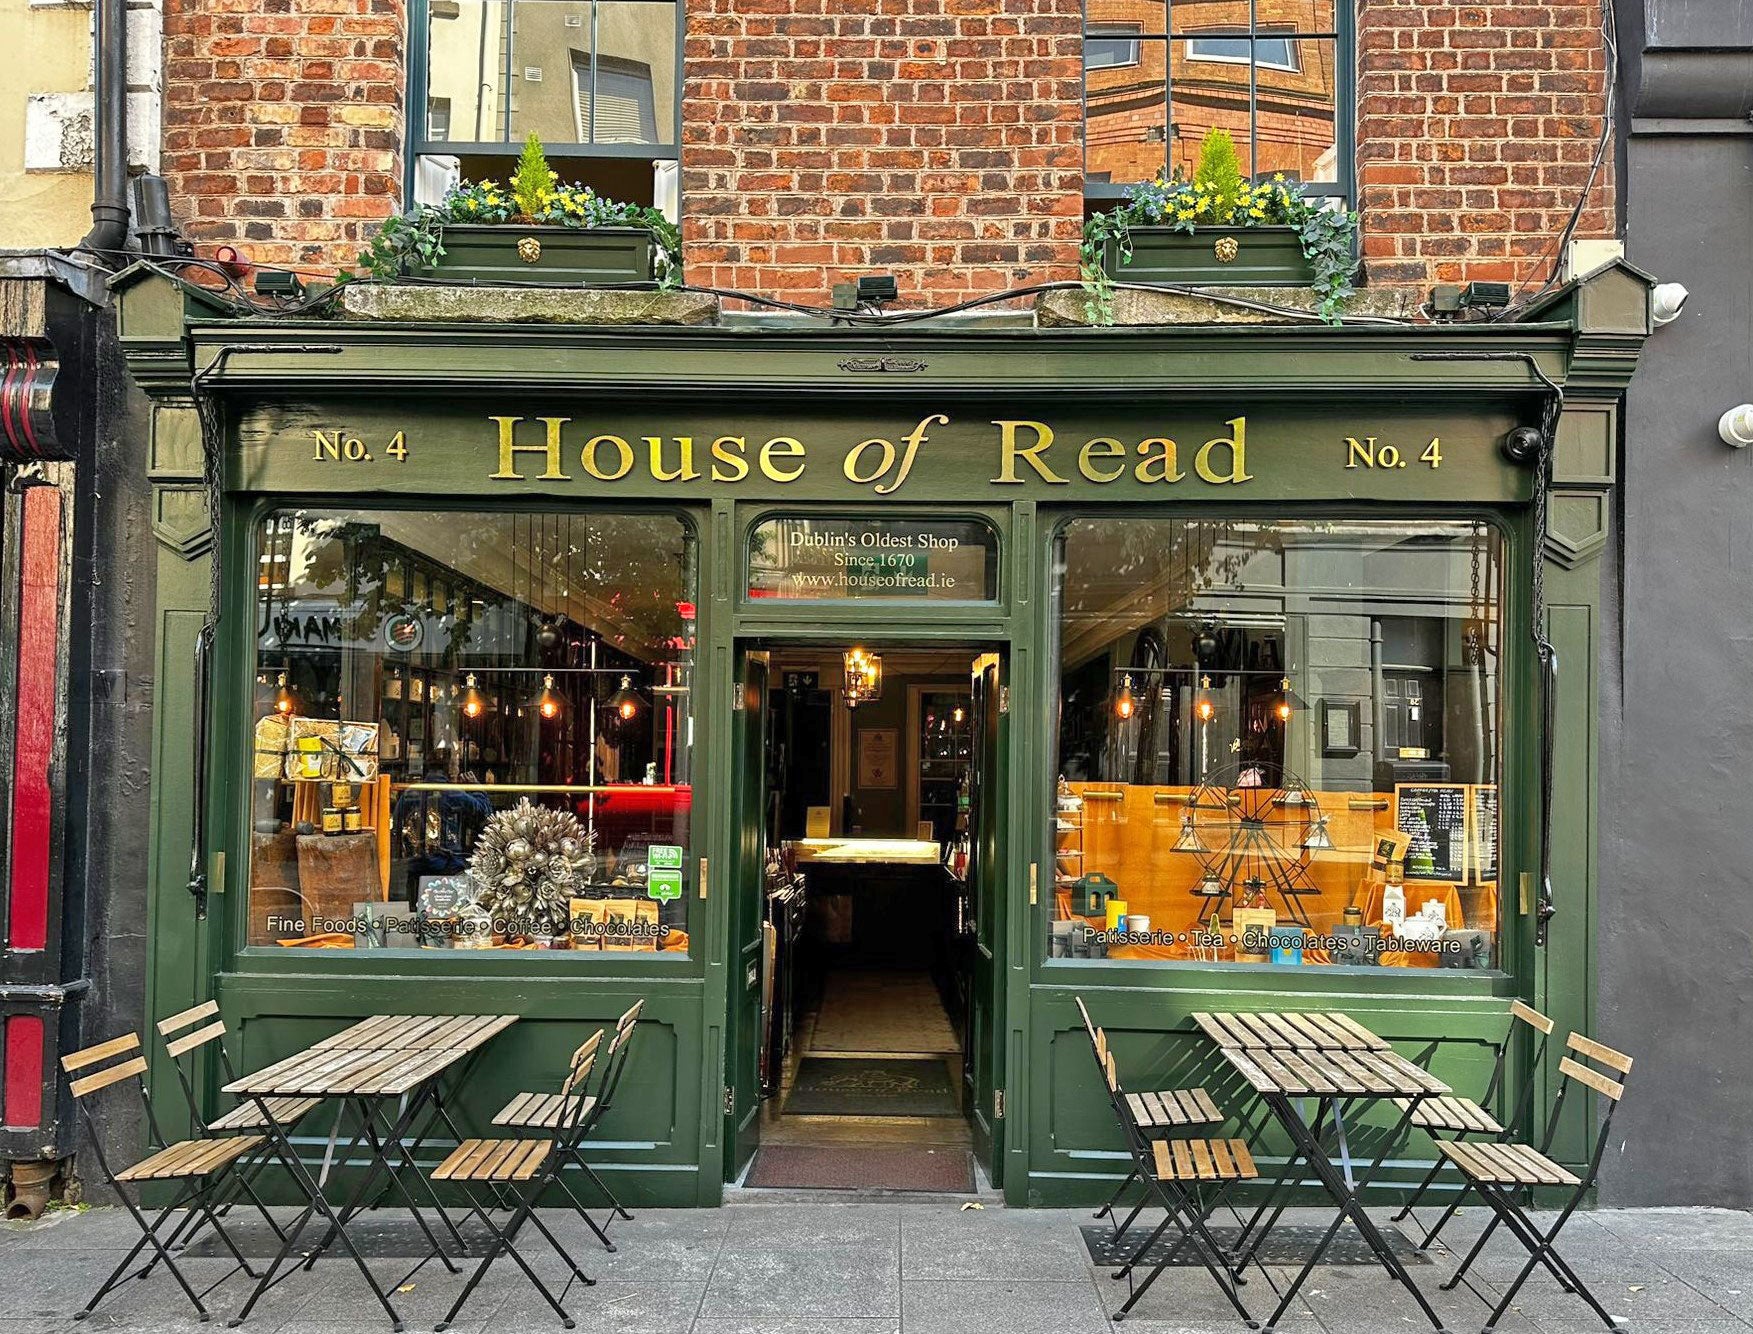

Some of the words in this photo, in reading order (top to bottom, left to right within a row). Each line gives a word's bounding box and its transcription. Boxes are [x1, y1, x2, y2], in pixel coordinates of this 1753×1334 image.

[313, 429, 372, 462] No.
[387, 429, 409, 462] 4
[488, 416, 807, 483] House
[842, 413, 950, 494] of
[990, 416, 1253, 485] Read
[1345, 435, 1407, 468] No.
[1419, 435, 1443, 467] 4
[790, 531, 856, 547] Dublin's
[860, 532, 914, 548] Oldest
[918, 533, 959, 552] Shop
[834, 552, 875, 566] Since
[880, 553, 915, 567] 1670
[791, 573, 956, 588] www.houseofread.ie
[266, 915, 305, 932] Fine
[310, 915, 367, 933] Foods
[385, 917, 475, 935] Patisserie
[493, 918, 553, 935] Coffee
[569, 919, 670, 937] Chocolates
[1082, 928, 1175, 946] Patisserie
[1191, 930, 1225, 948] Tea
[1242, 931, 1347, 951] Chocolates
[1364, 934, 1462, 955] Tableware
